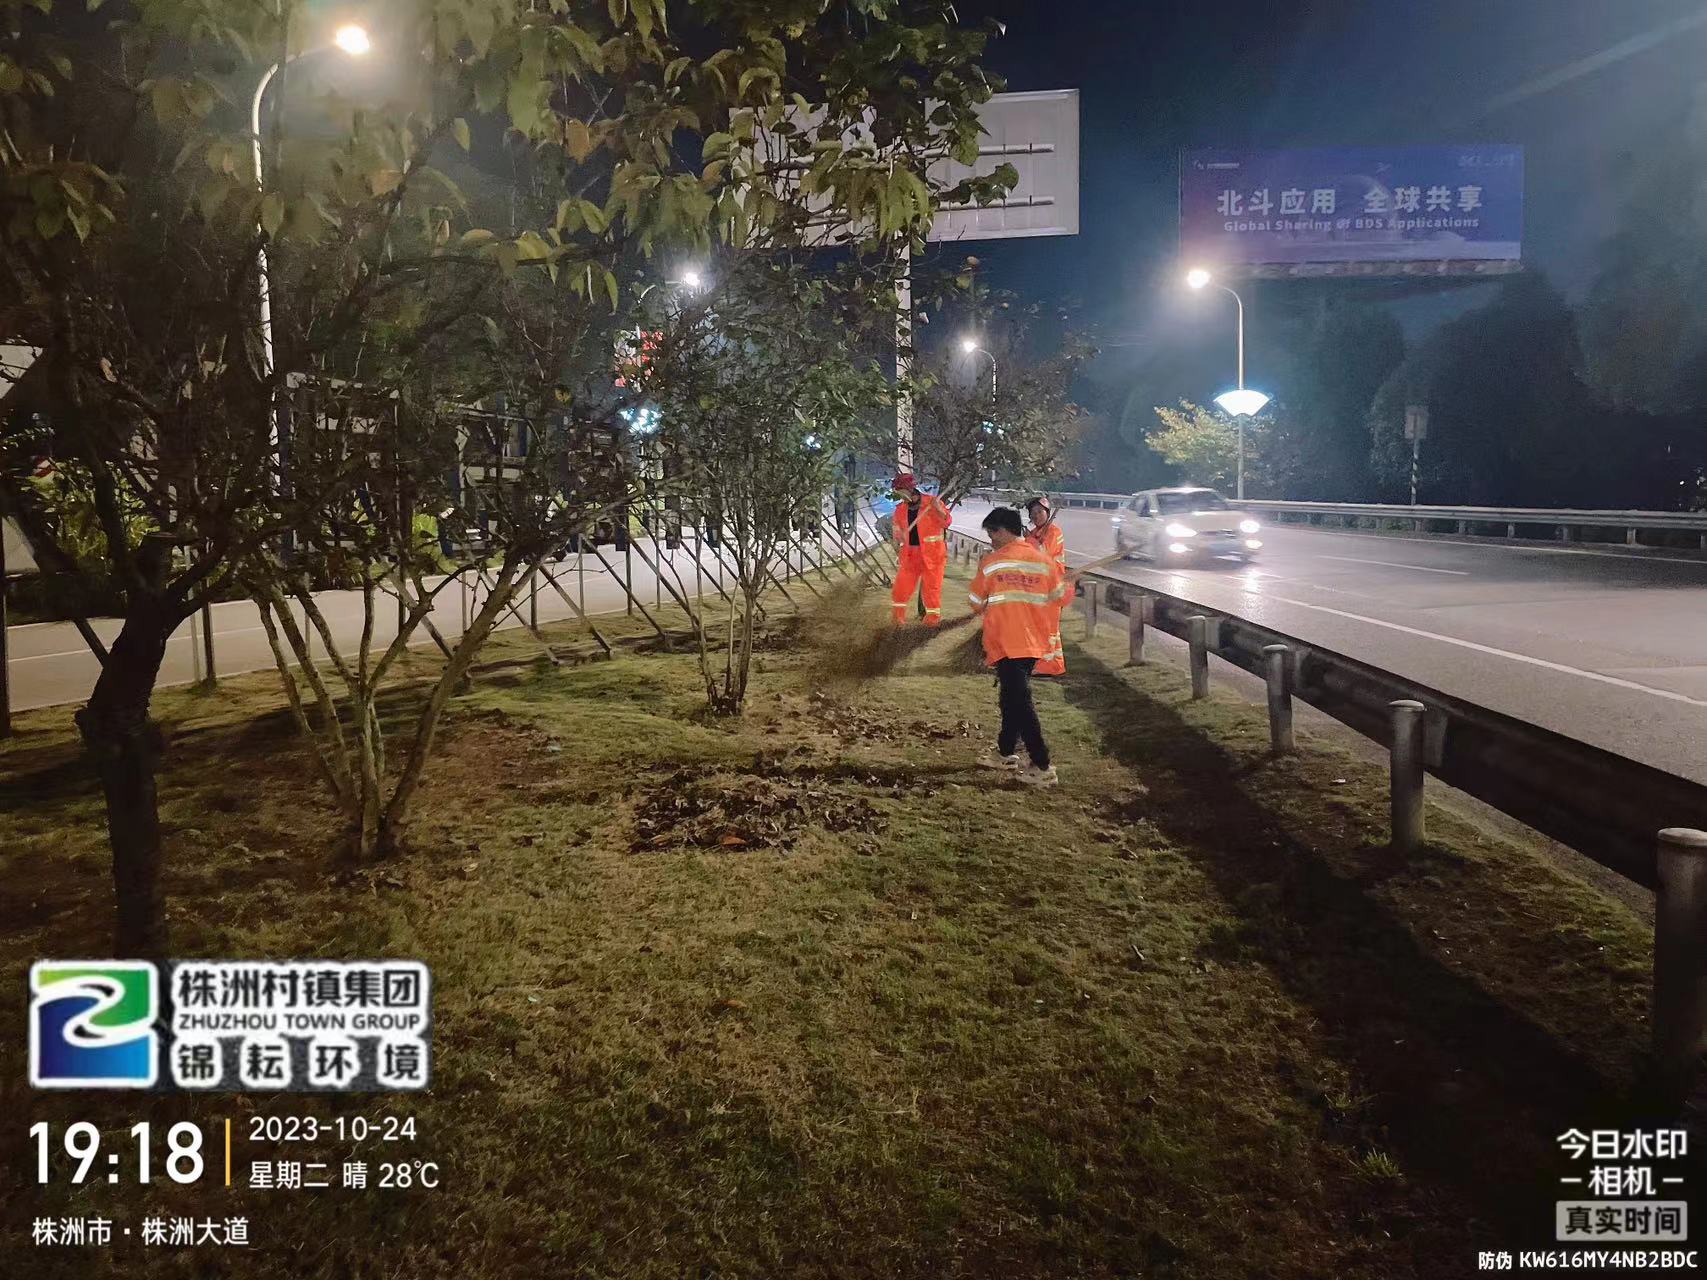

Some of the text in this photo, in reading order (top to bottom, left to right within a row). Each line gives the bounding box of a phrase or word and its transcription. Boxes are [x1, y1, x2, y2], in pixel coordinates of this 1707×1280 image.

[1216, 185, 1483, 216] 北斗应用 全球共享
[1224, 219, 1271, 233] Global
[1275, 219, 1332, 233] Sharing
[1355, 217, 1383, 229] BDS
[1387, 216, 1480, 232] Applications
